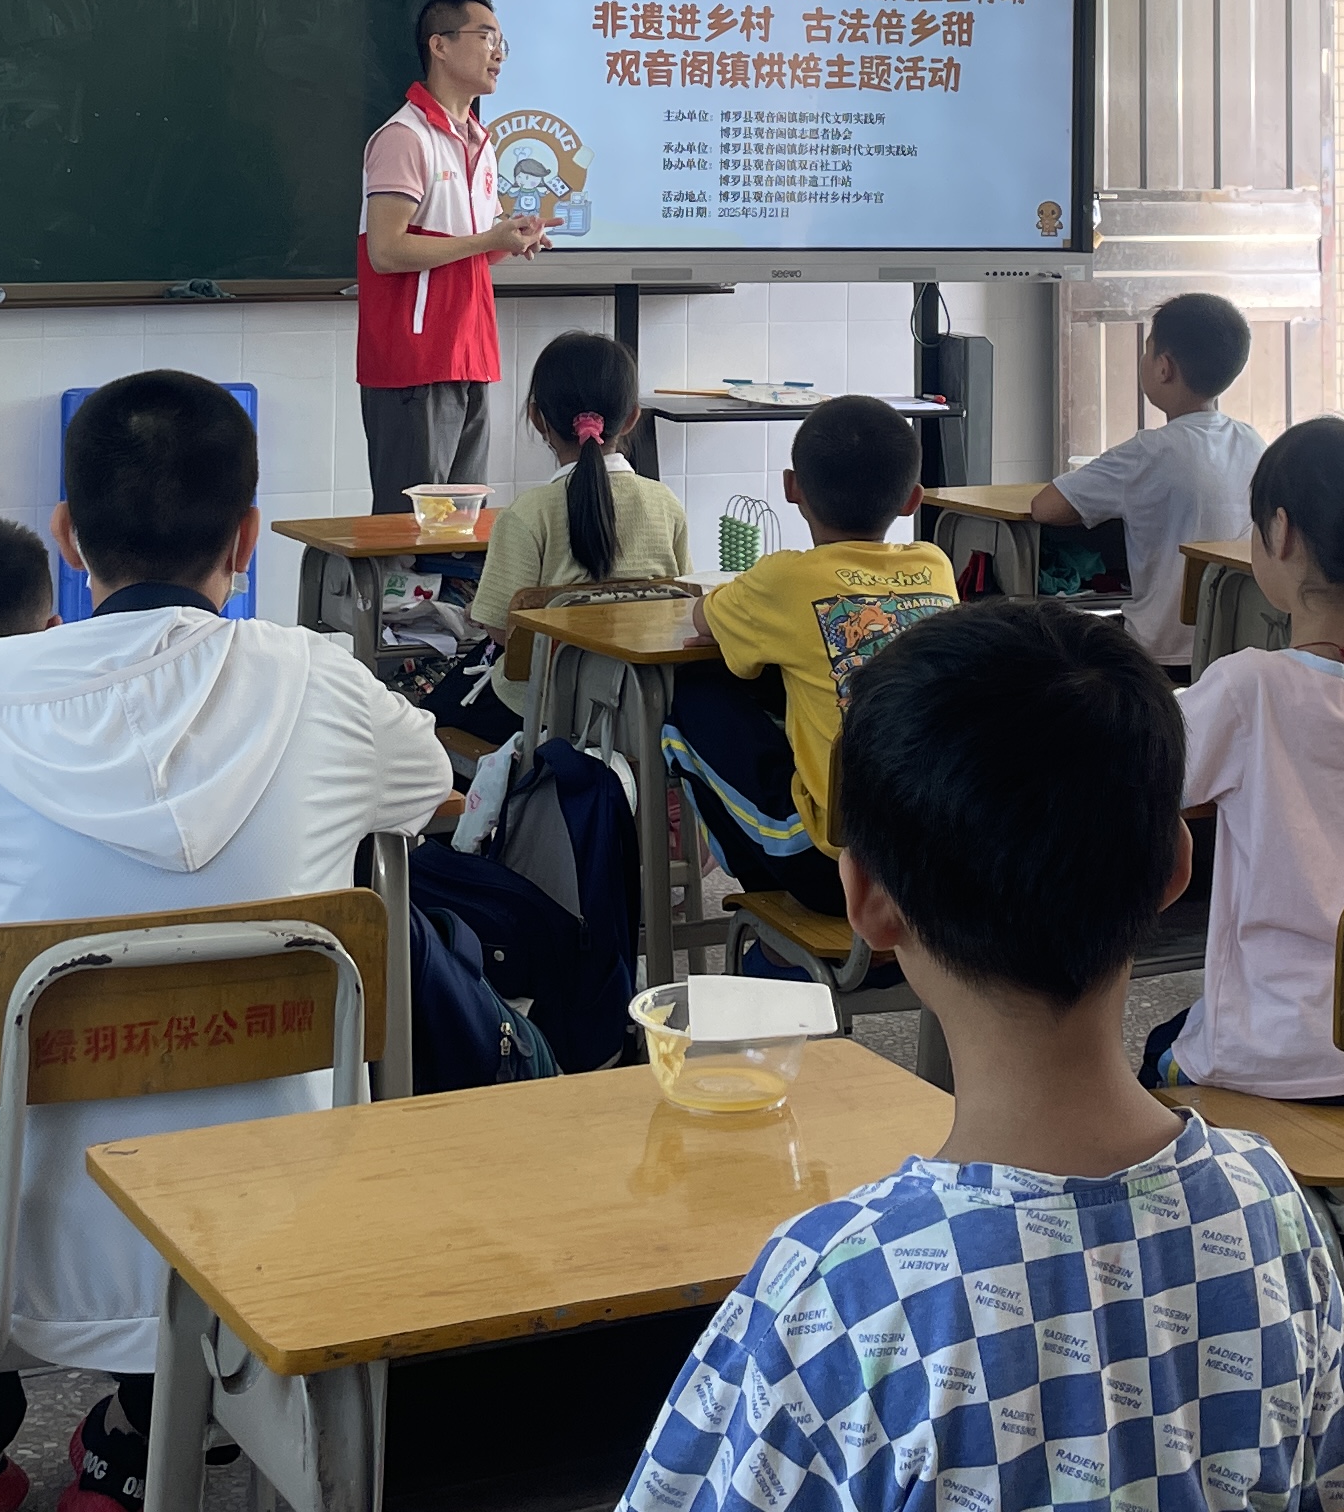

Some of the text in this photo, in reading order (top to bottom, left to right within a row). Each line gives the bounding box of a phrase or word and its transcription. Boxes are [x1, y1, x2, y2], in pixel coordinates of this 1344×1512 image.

[592, 0, 775, 44] 非遗进乡村
[605, 49, 963, 93] 观音阁镇烘焙主题活动
